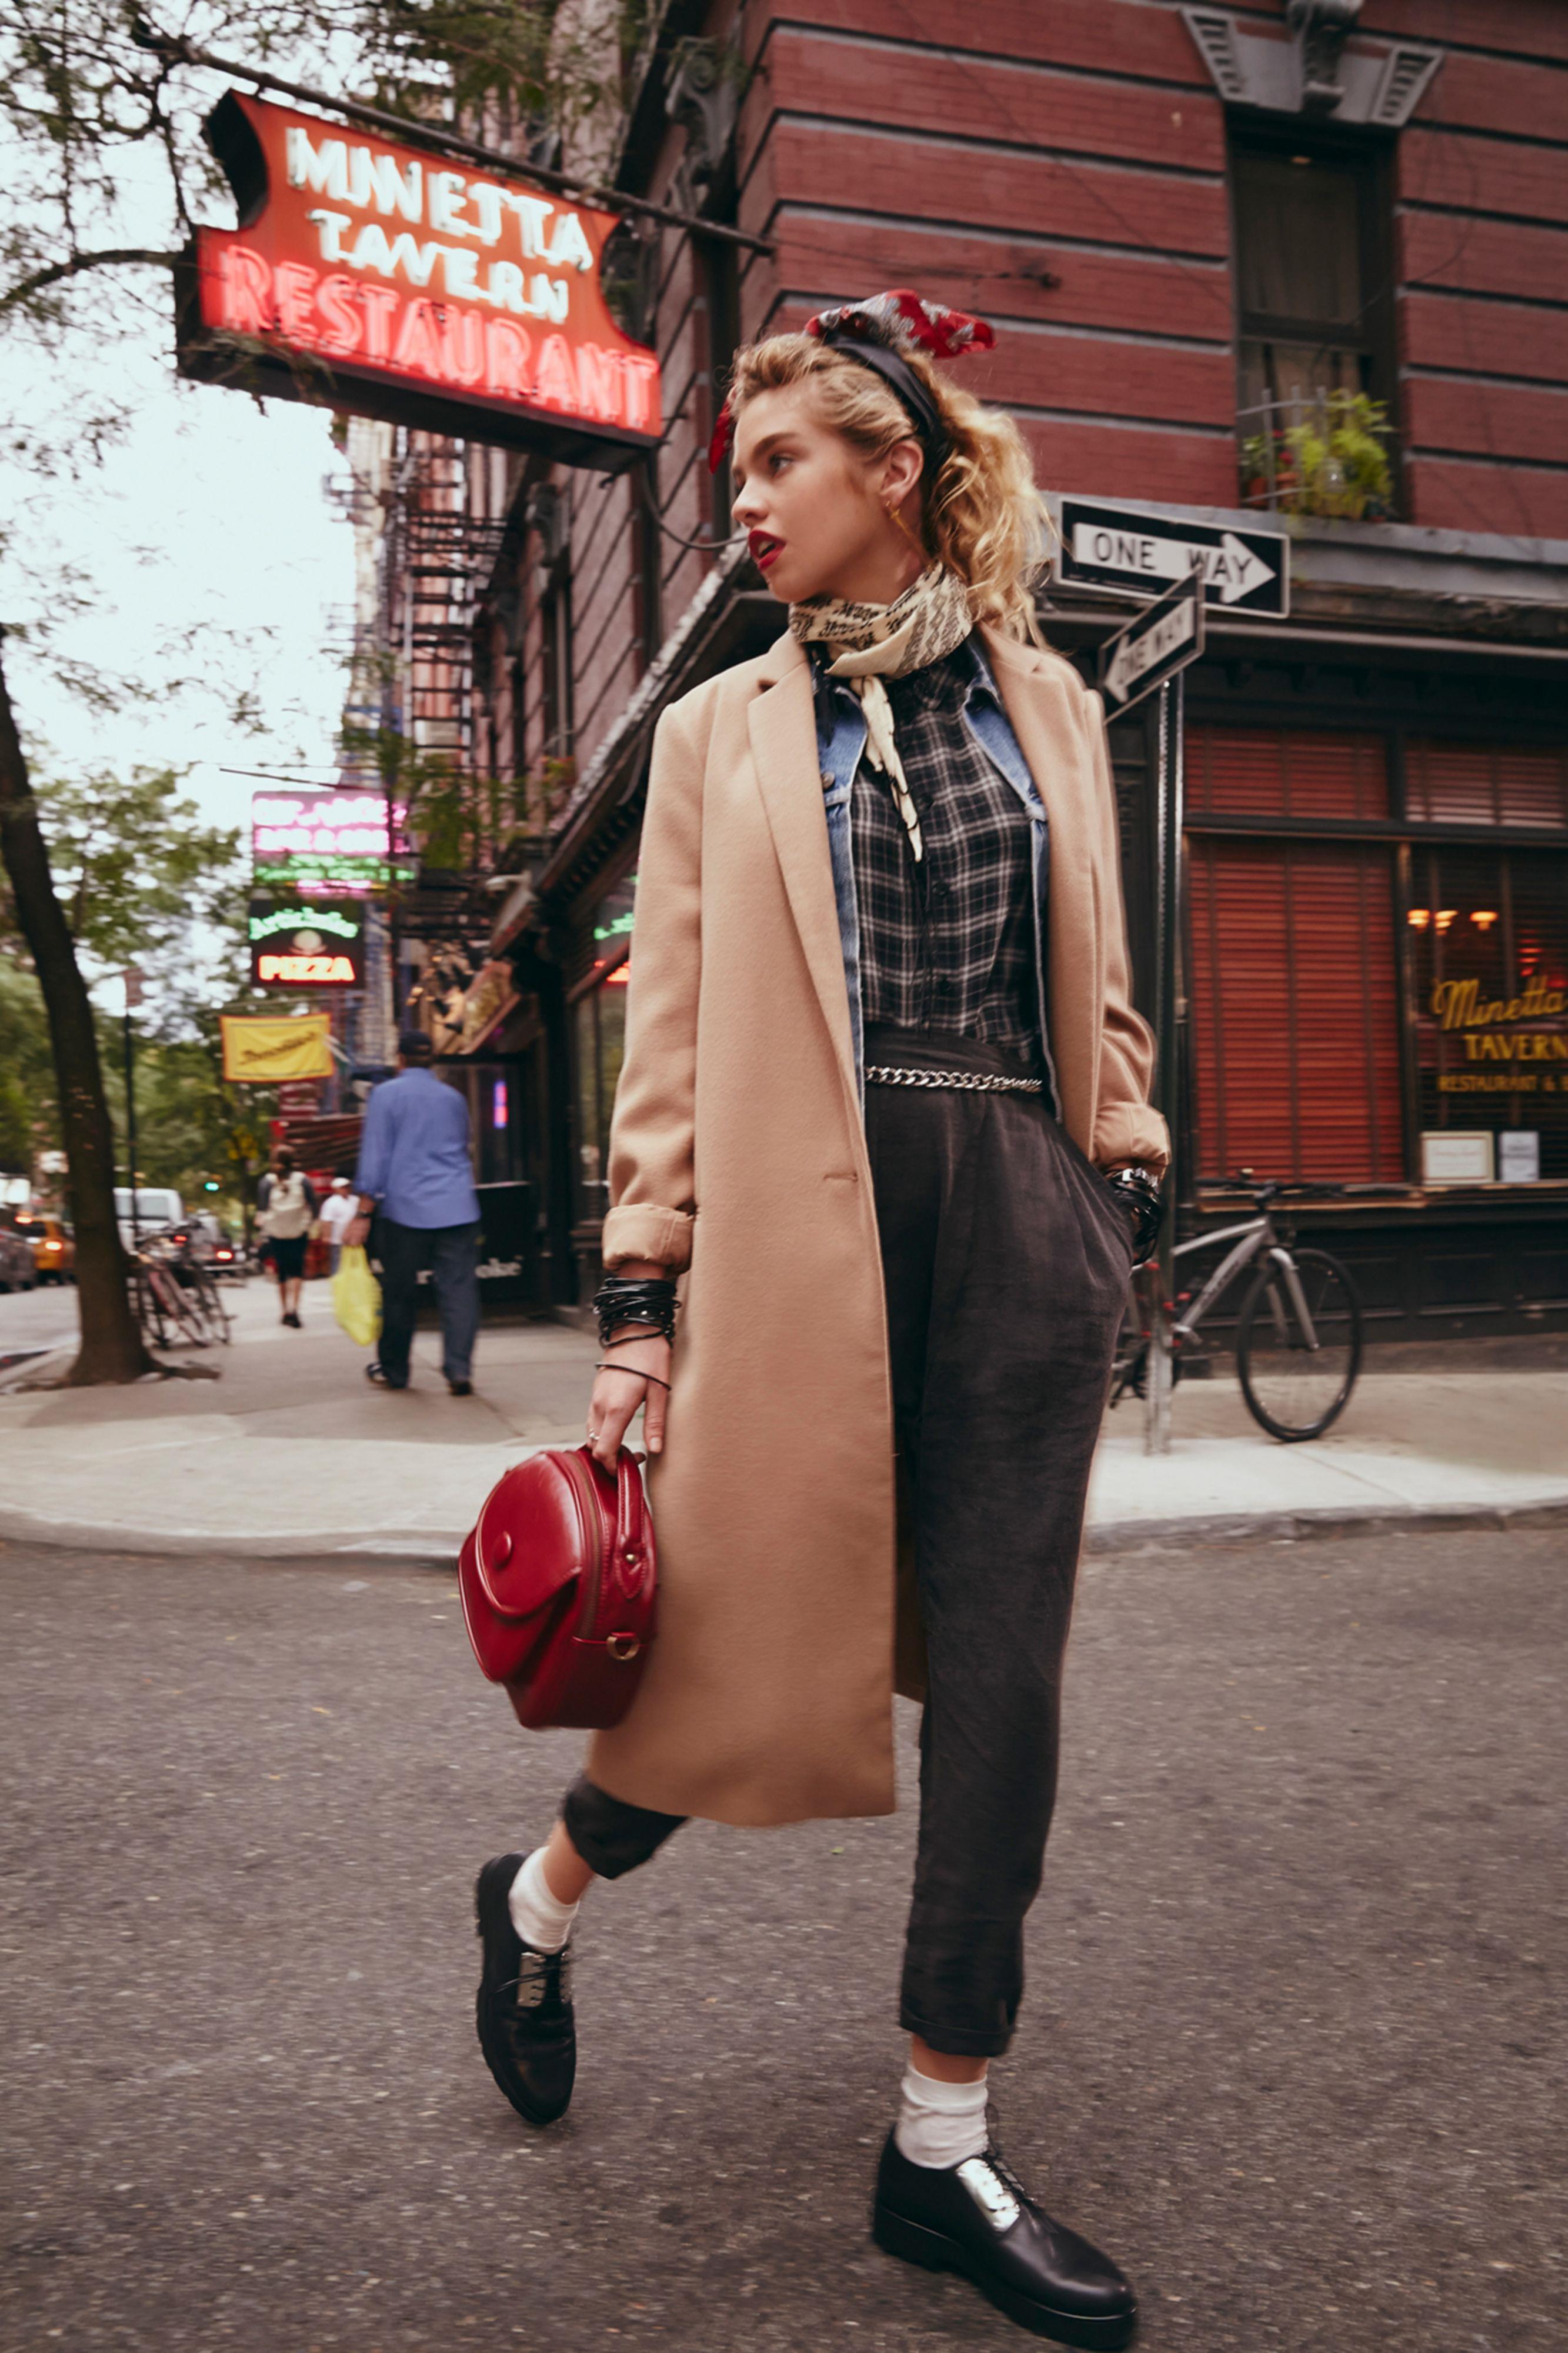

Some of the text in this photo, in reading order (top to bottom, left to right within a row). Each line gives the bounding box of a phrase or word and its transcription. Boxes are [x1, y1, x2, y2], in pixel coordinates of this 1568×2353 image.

[308, 209, 569, 324] TAVERN
[218, 245, 659, 431] RESTAURANT
[1095, 532, 1156, 570] ONE
[1187, 548, 1253, 584] WAY
[259, 955, 355, 981] PIZZA
[1431, 975, 1568, 1031] Minetta
[1437, 1075, 1537, 1092] RESTAURANT
